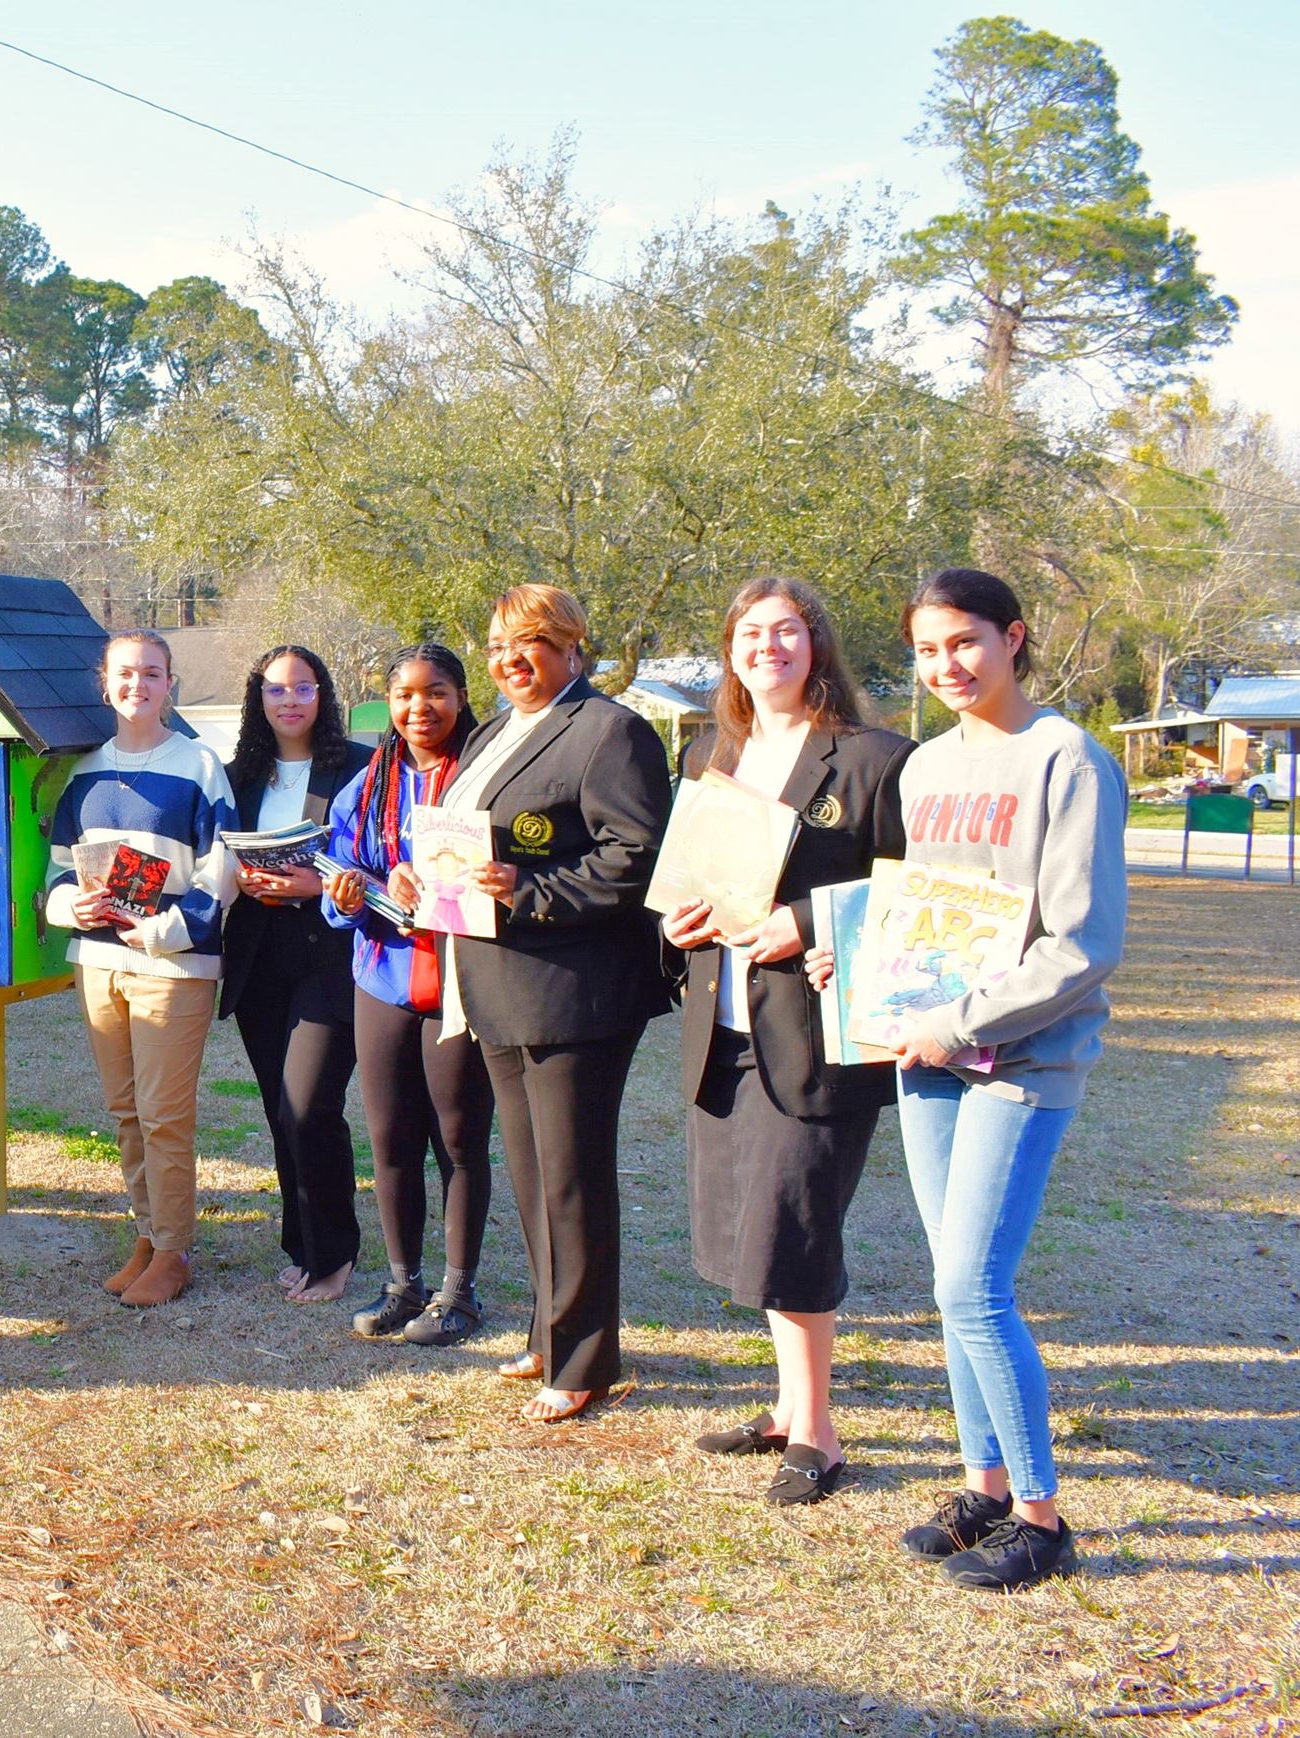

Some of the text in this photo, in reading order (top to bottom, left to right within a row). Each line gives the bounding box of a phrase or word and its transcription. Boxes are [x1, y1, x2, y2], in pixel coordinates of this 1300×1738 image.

[416, 808, 486, 841] Silverlicious
[521, 820, 542, 838] D
[113, 897, 146, 916] NAZI
[901, 870, 1025, 920] SUPERHERO
[904, 906, 998, 964] ABC
